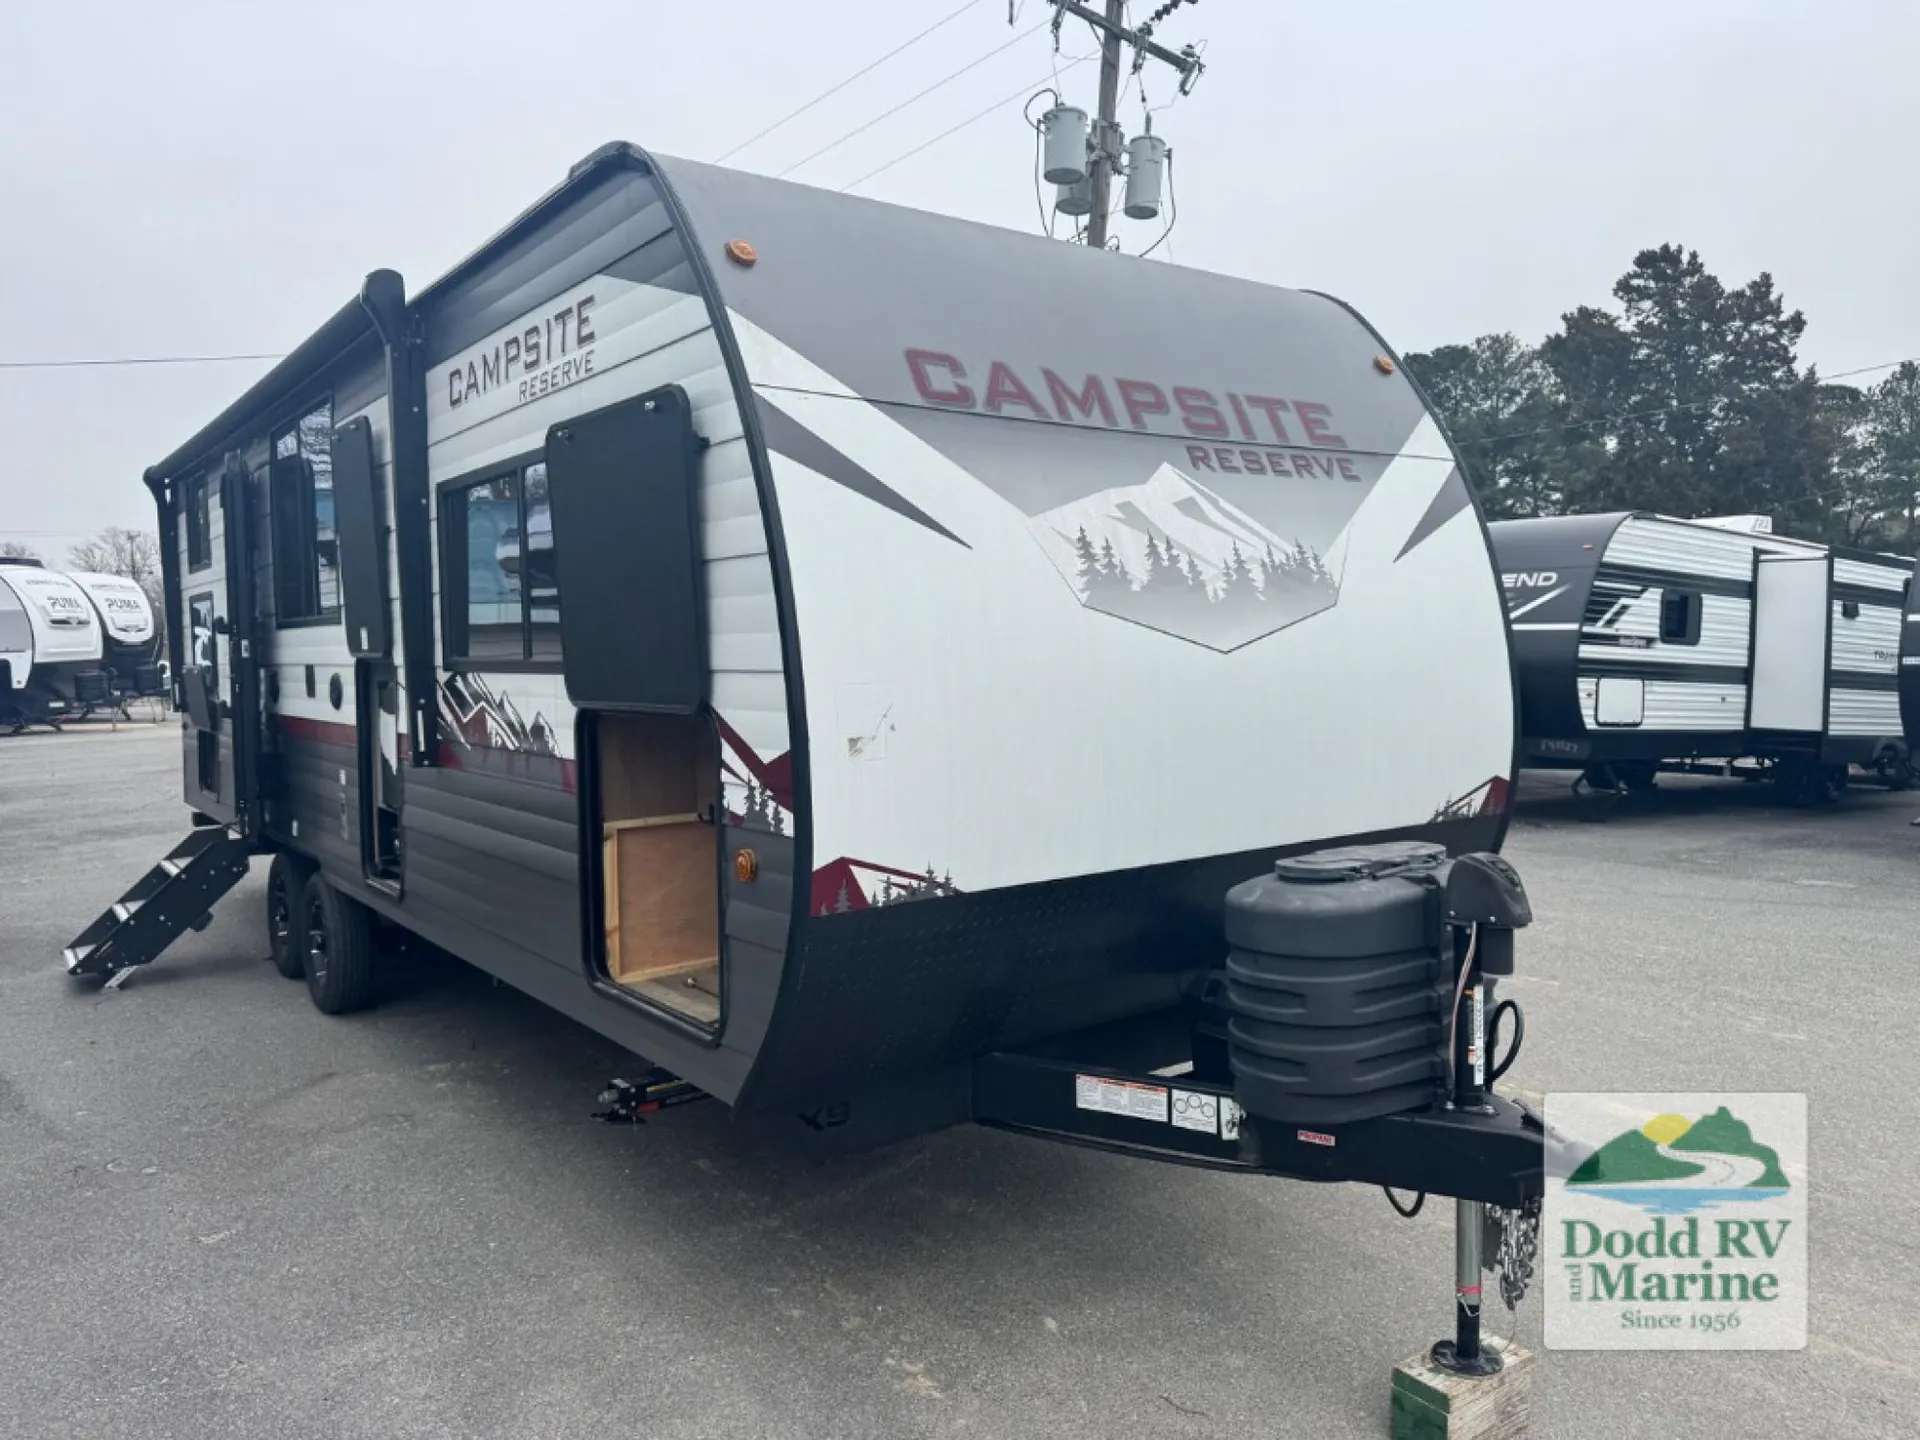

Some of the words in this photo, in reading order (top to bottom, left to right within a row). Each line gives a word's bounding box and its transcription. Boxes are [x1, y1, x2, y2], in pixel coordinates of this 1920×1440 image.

[449, 294, 596, 410] CAMPSITE
[518, 349, 595, 404] RESERVE
[904, 347, 1348, 449] CAMPSITE
[1187, 444, 1362, 482] RESERVE
